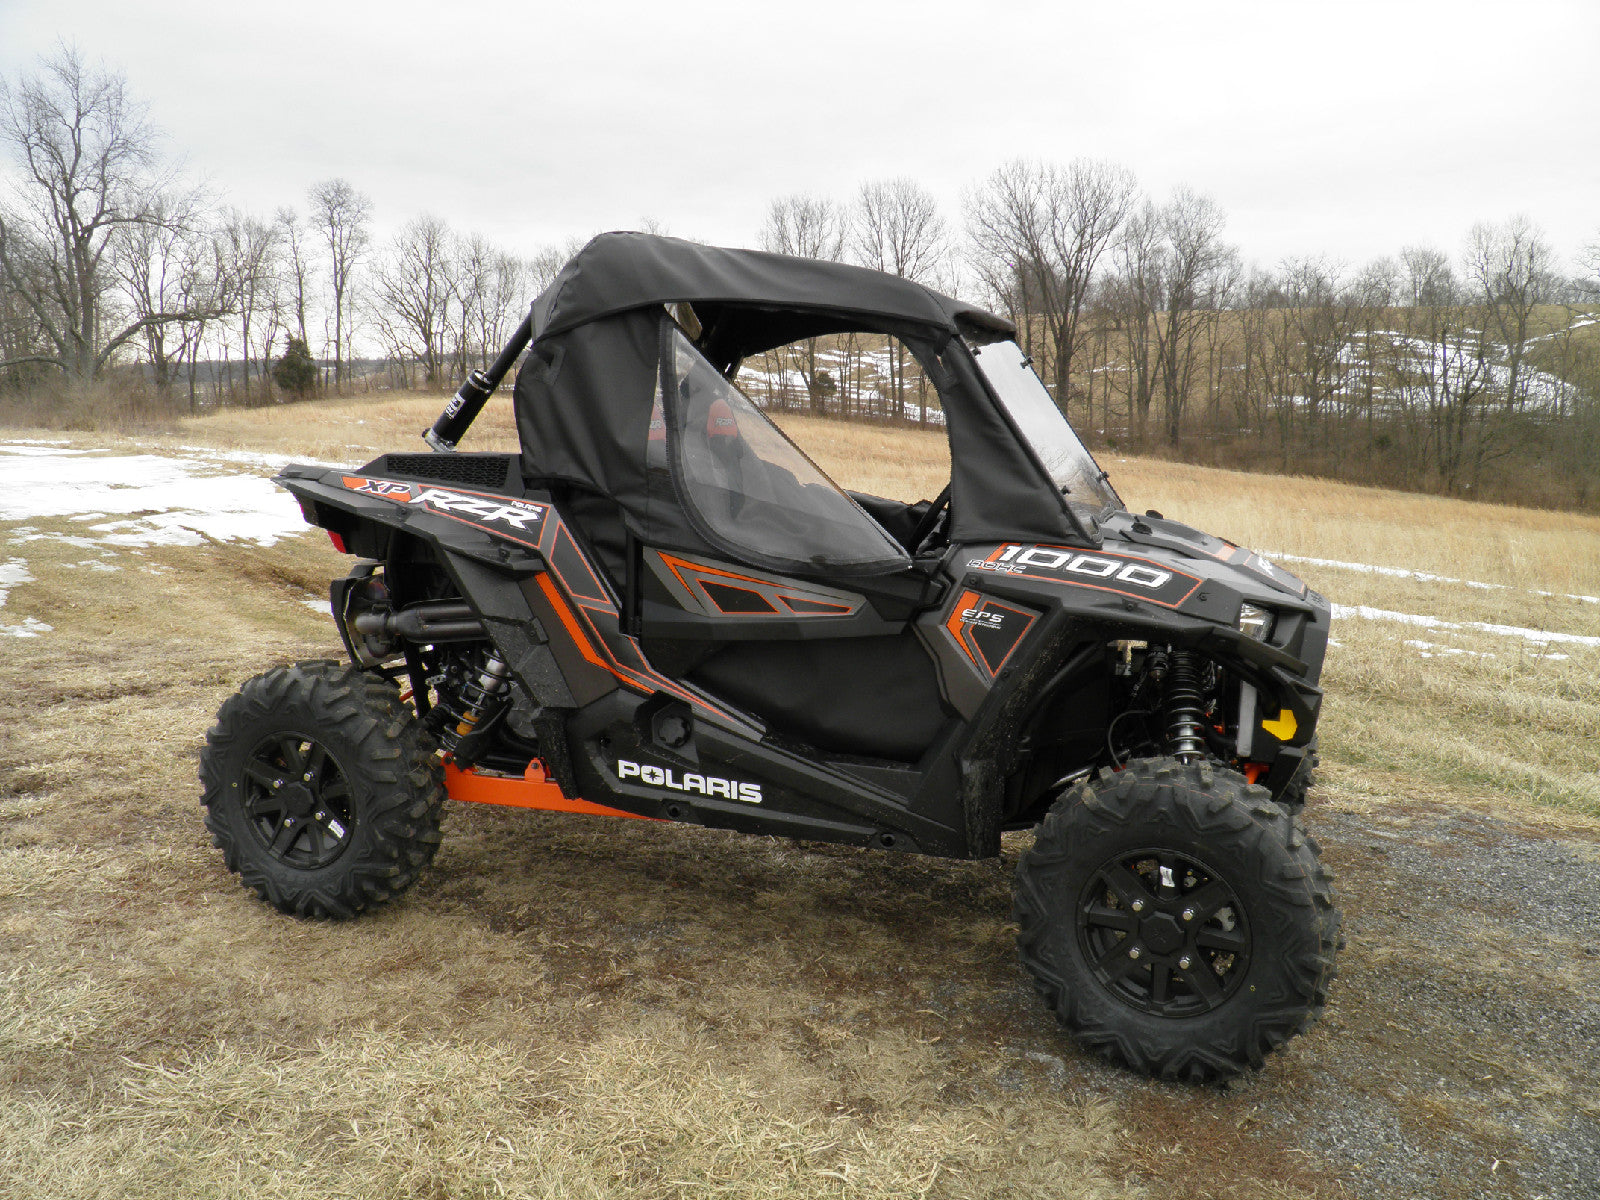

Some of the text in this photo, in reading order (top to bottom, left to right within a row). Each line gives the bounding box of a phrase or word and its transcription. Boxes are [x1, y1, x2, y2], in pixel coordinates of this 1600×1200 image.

[353, 479, 411, 495] XP
[408, 488, 541, 531] RZR
[511, 500, 543, 513] POLARIS
[999, 545, 1170, 588] 1000
[961, 608, 1004, 623] EPS
[618, 759, 763, 804] POLARIS
